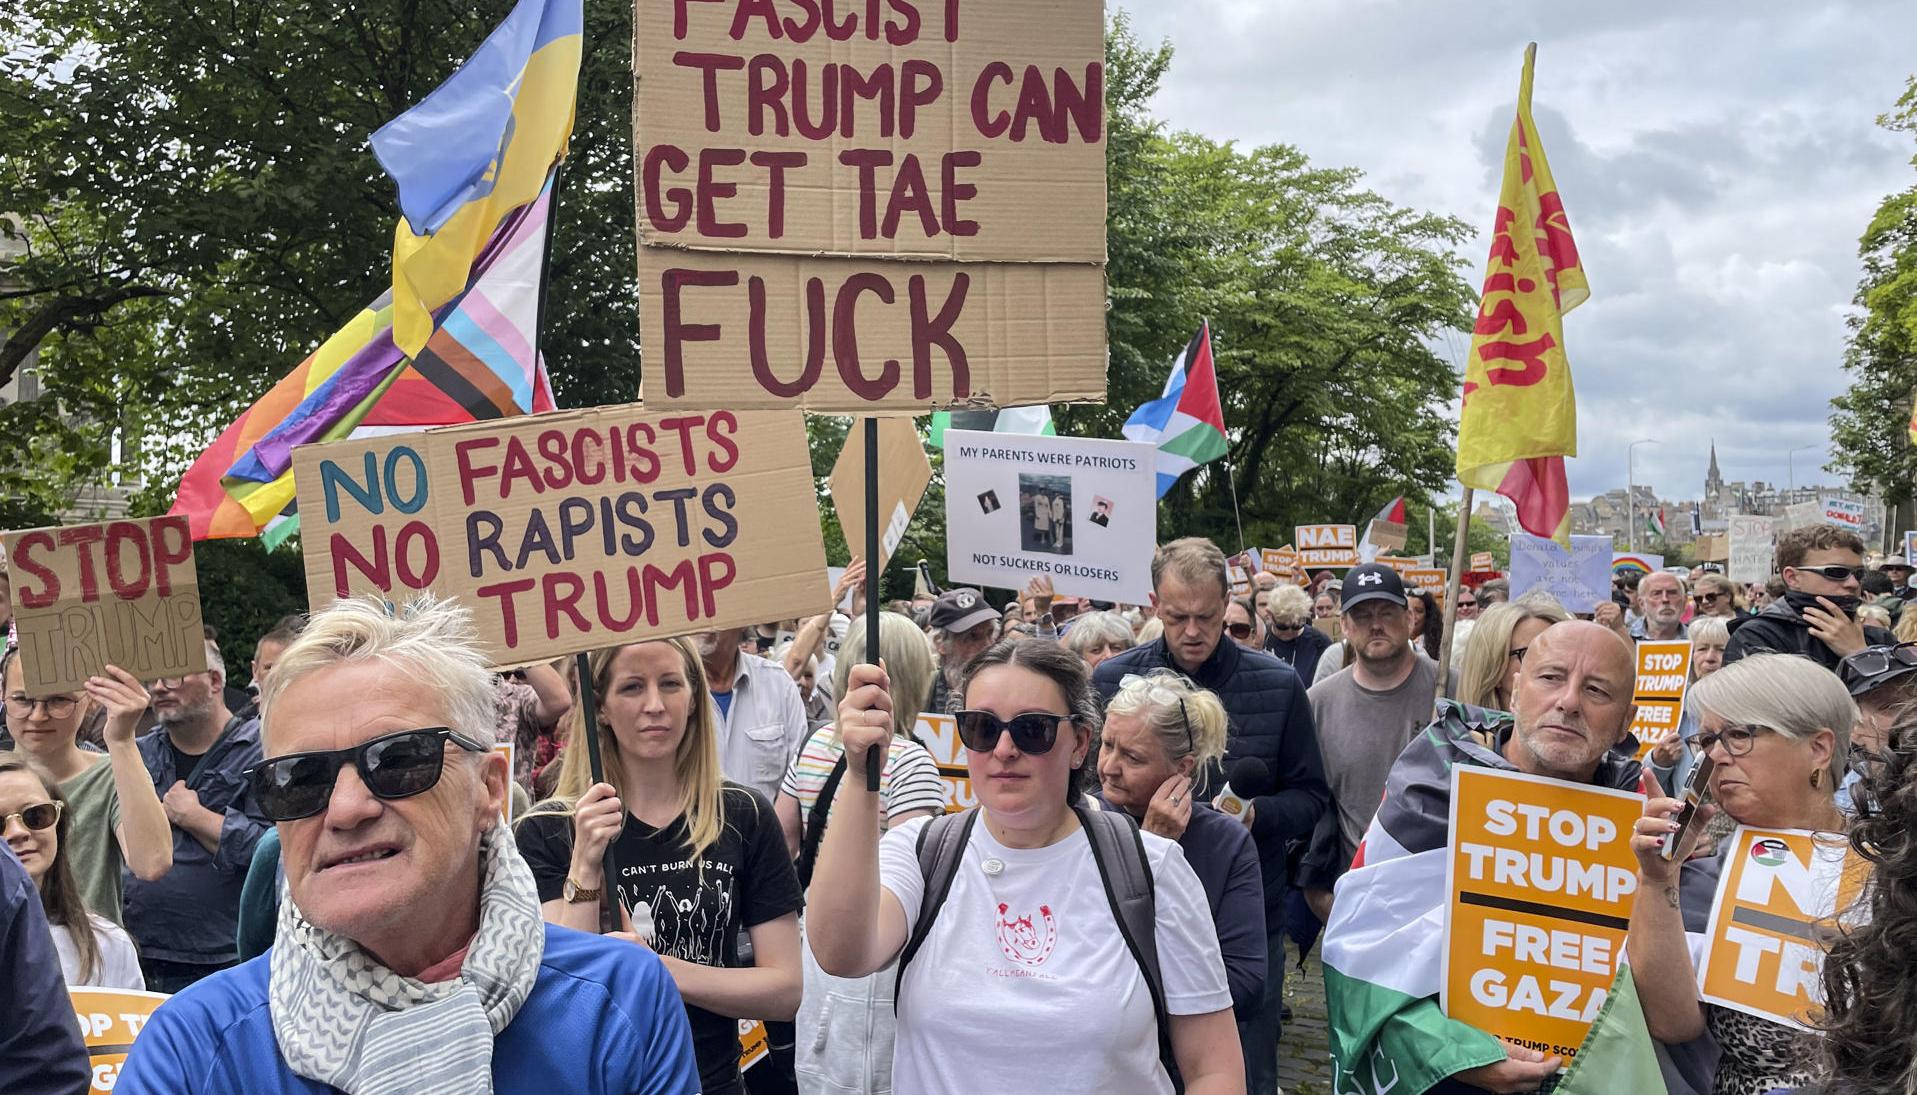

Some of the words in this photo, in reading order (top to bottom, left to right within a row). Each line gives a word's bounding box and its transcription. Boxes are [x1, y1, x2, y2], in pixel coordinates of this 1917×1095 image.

[672, 52, 943, 140] TRUMP
[970, 61, 1102, 143] CAN
[643, 144, 808, 239] GET
[838, 149, 982, 239] TAE
[662, 268, 970, 400] FUCK
[320, 446, 428, 523] NO
[455, 410, 739, 506] FASCISTS
[960, 447, 978, 457] MY
[982, 448, 1034, 462] PARENTS
[1037, 453, 1072, 465] WERE
[1075, 455, 1136, 470] PATRIOTS
[331, 520, 440, 598] NO
[466, 483, 738, 577] RAPISTS
[1300, 527, 1353, 546] NAE
[1301, 550, 1354, 563] TRUMP
[12, 517, 193, 609] STOP
[973, 553, 997, 566] NOT
[1000, 556, 1051, 572] SUCKERS
[1054, 563, 1071, 575] OR
[1074, 566, 1118, 581] LOSERS
[1267, 554, 1291, 563] STOP
[1411, 574, 1439, 583] STOP
[477, 552, 737, 648] TRUMP
[16, 592, 201, 685] TRUMP
[1644, 653, 1683, 671] STOP
[1638, 674, 1685, 691] TRUMP
[1635, 705, 1673, 723] FREE
[1483, 799, 1617, 851] STOP
[622, 865, 657, 876] CAN'T
[662, 860, 693, 872] BURN
[698, 860, 712, 869] US
[716, 862, 733, 875] ALL
[1460, 841, 1637, 904] TRUMP
[1482, 918, 1612, 976] FREE
[1552, 1045, 1578, 1057] SCO
